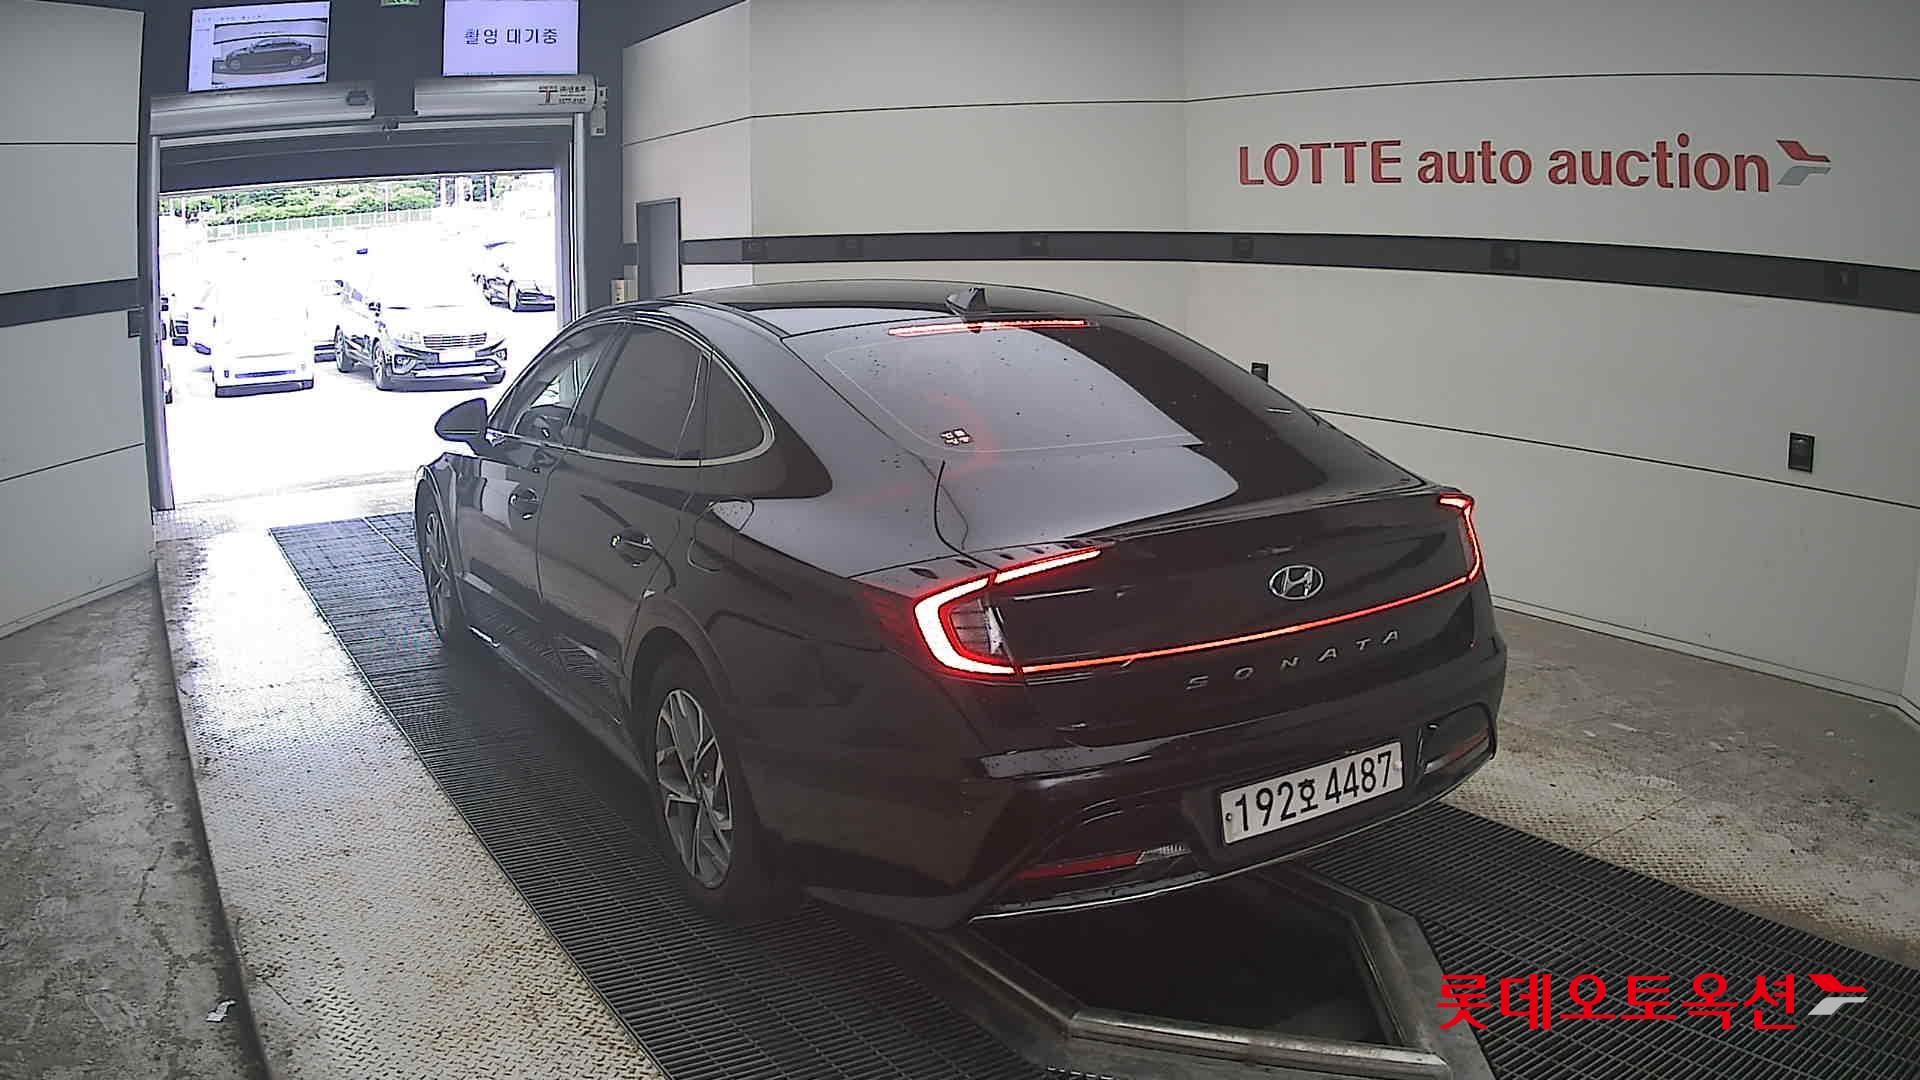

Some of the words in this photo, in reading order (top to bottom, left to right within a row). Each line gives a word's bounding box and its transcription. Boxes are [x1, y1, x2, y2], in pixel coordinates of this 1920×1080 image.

[506, 28, 559, 45] 대기중
[1239, 140, 1402, 186] LOTTE
[1417, 140, 1532, 184] auto
[1548, 132, 1770, 193] auction
[1186, 630, 1399, 690] SONATA
